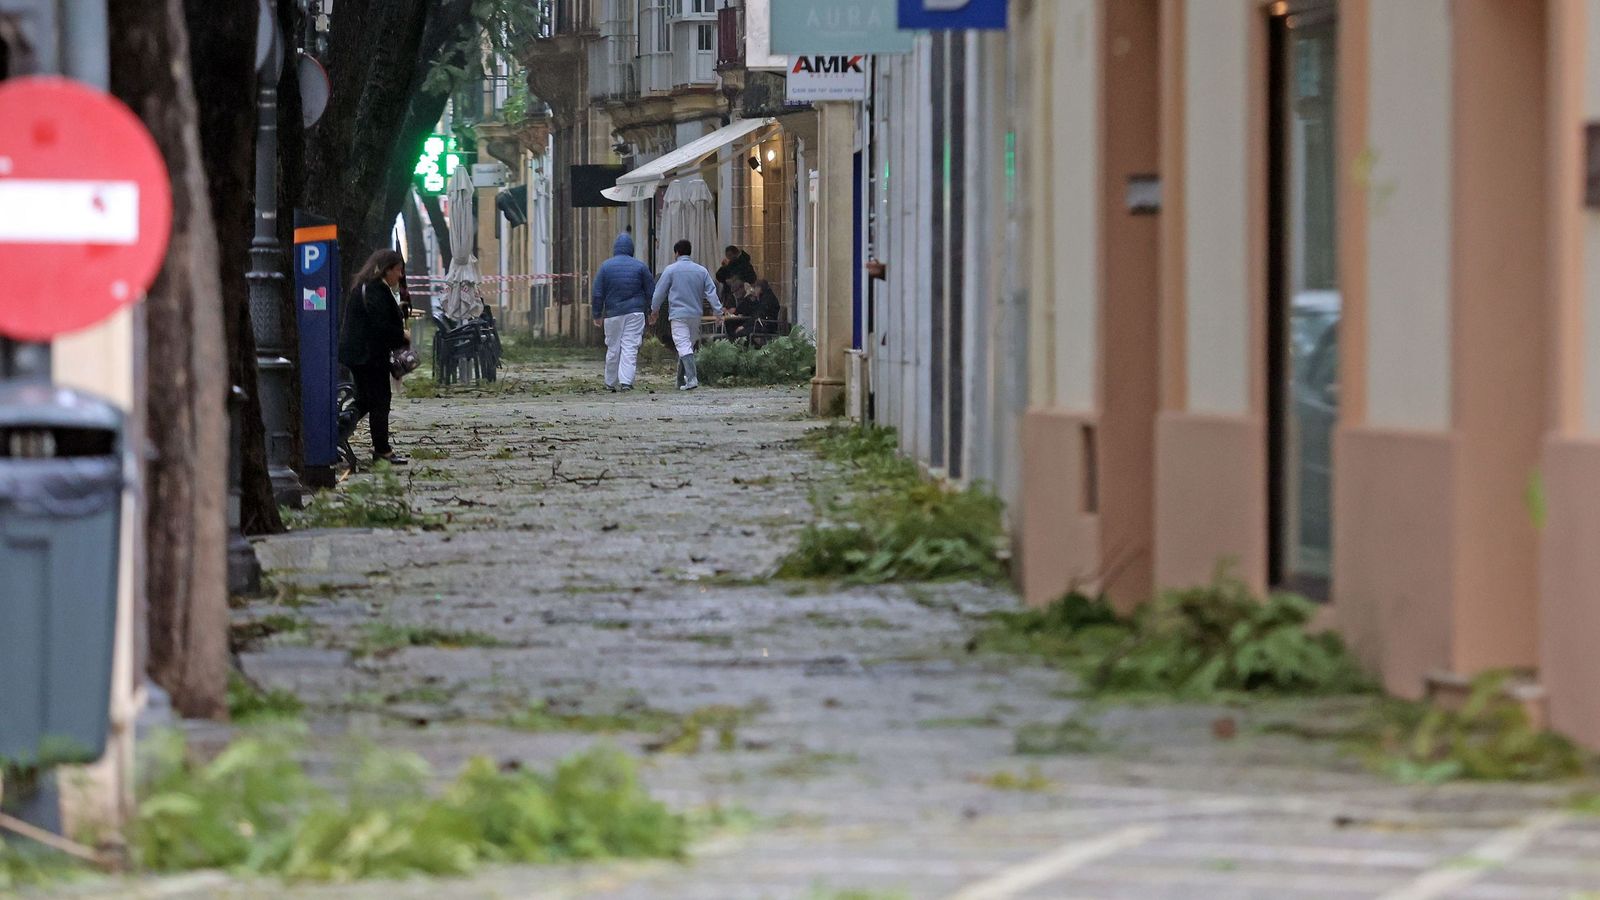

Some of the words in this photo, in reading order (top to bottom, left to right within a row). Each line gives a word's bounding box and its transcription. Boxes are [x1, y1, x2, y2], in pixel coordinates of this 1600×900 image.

[806, 6, 882, 27] AURA
[792, 55, 863, 73] AMK
[304, 245, 320, 270] P
